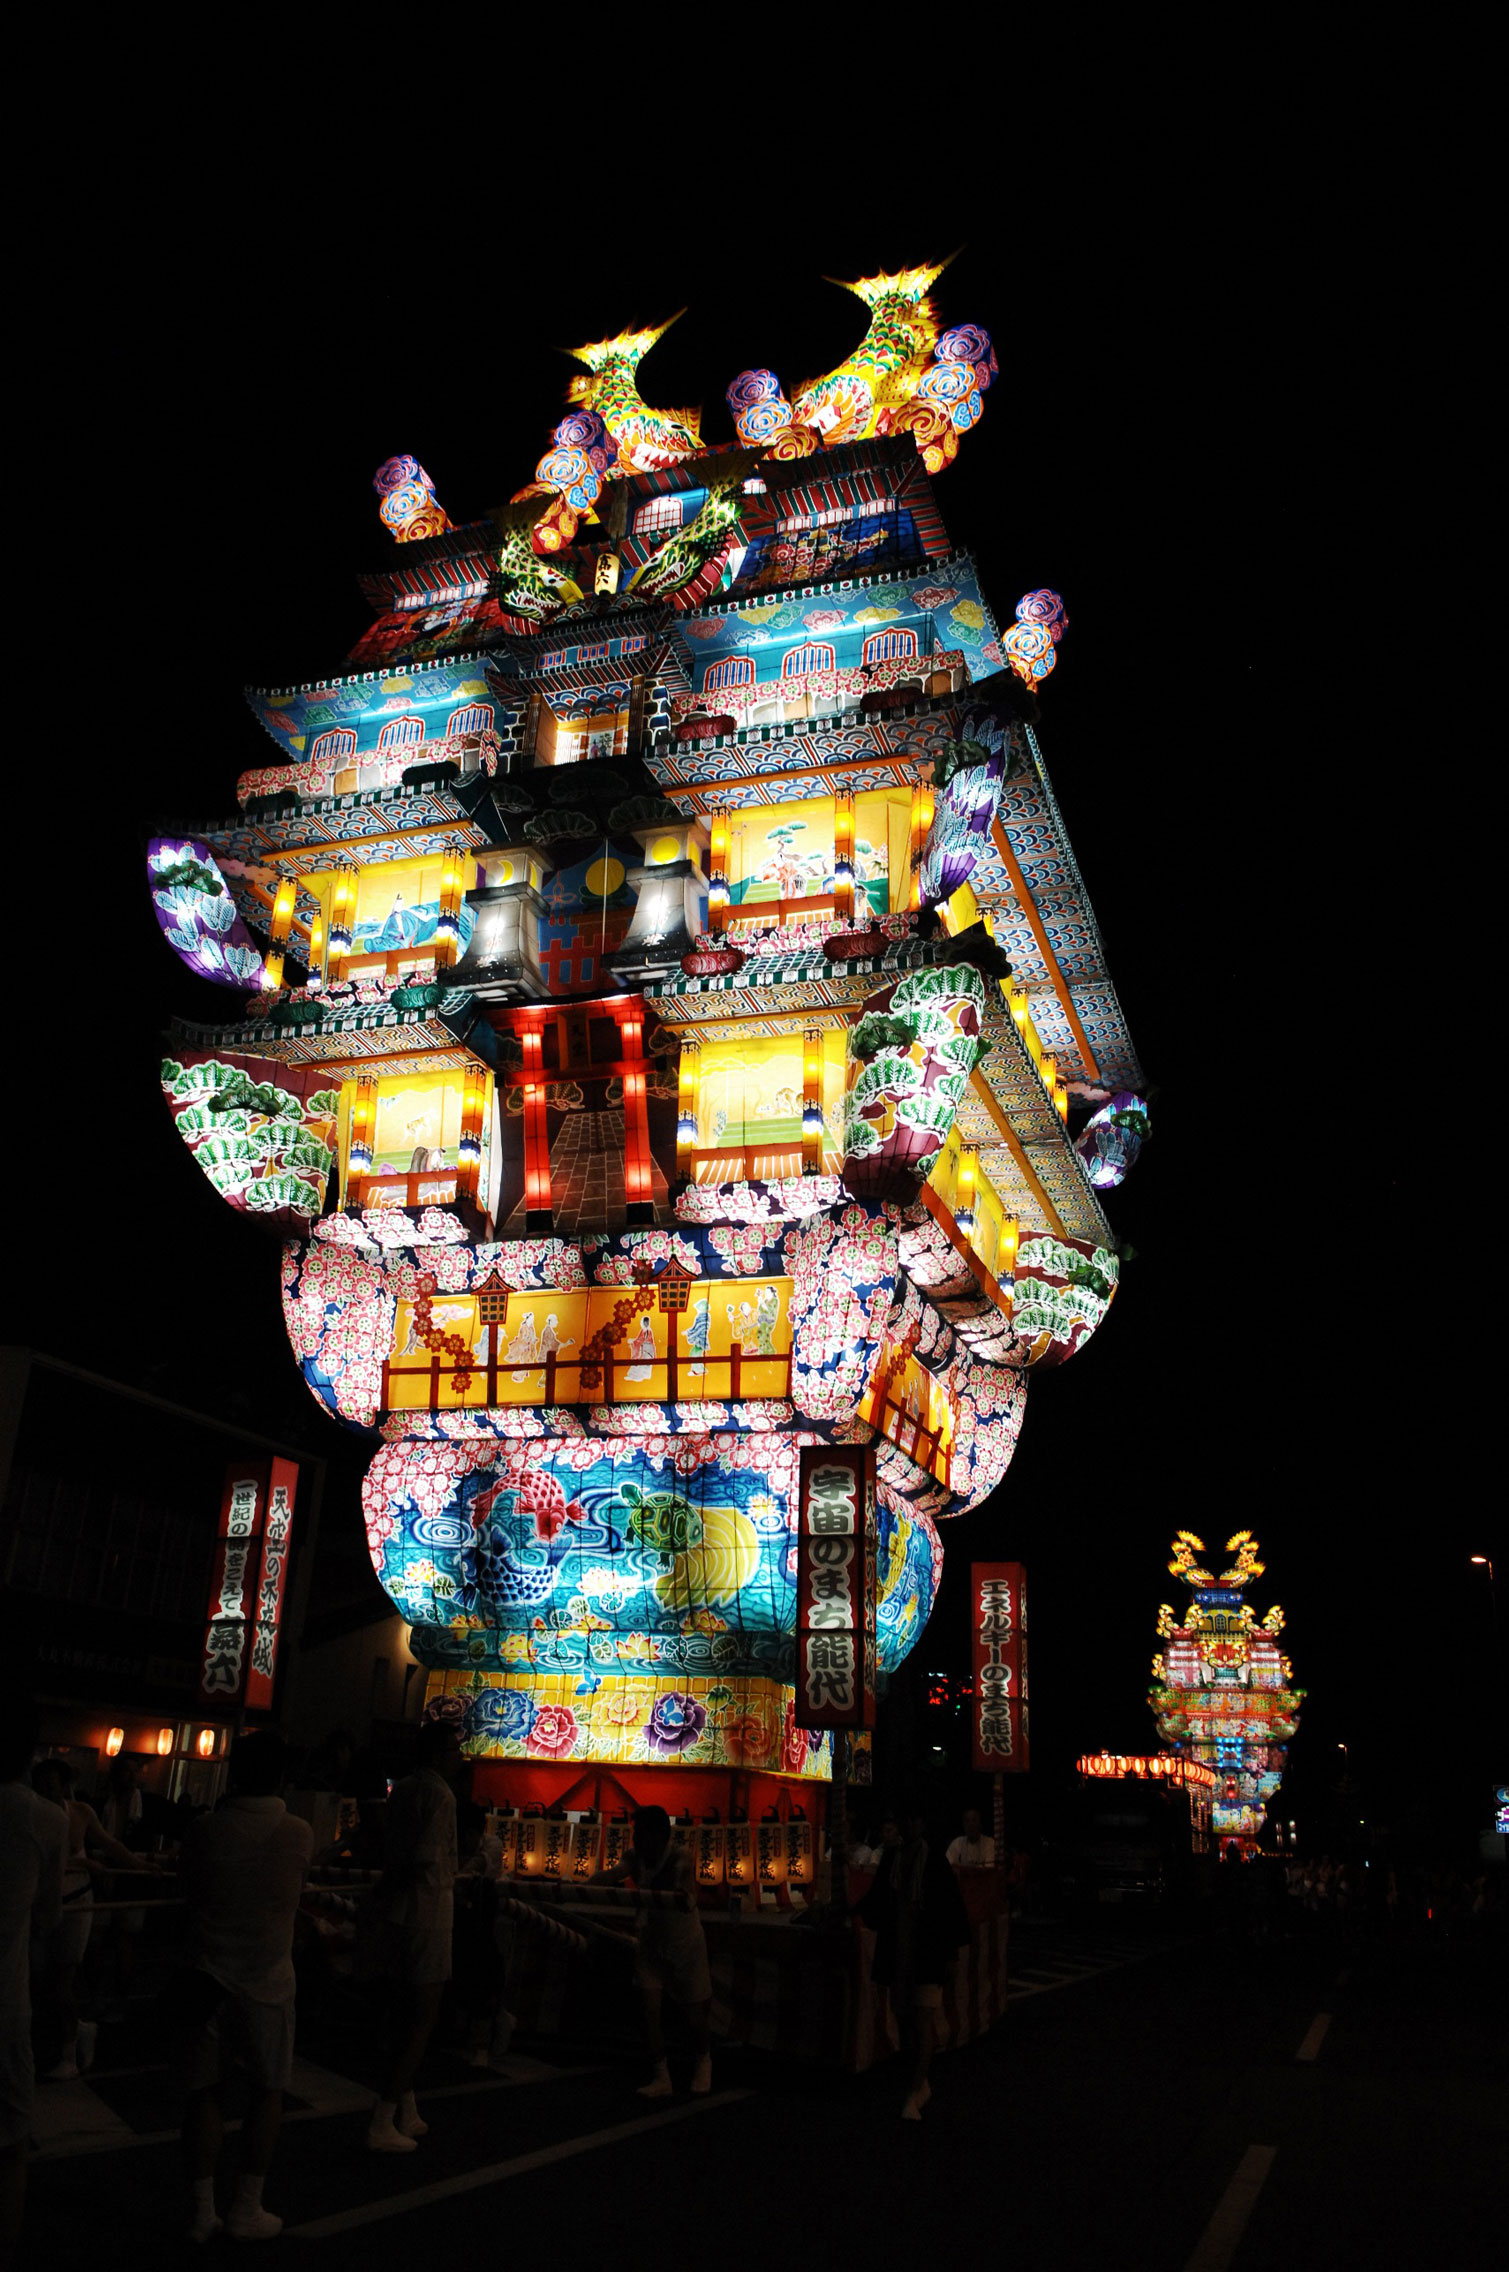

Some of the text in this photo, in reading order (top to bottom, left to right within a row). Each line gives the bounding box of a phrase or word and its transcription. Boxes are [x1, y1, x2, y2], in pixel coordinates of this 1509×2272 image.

[253, 1489, 288, 1673] 天空の不夜城
[811, 1470, 851, 1704] 宇宙のまち能代
[982, 1581, 1011, 1753] エネルギーのまち能代
